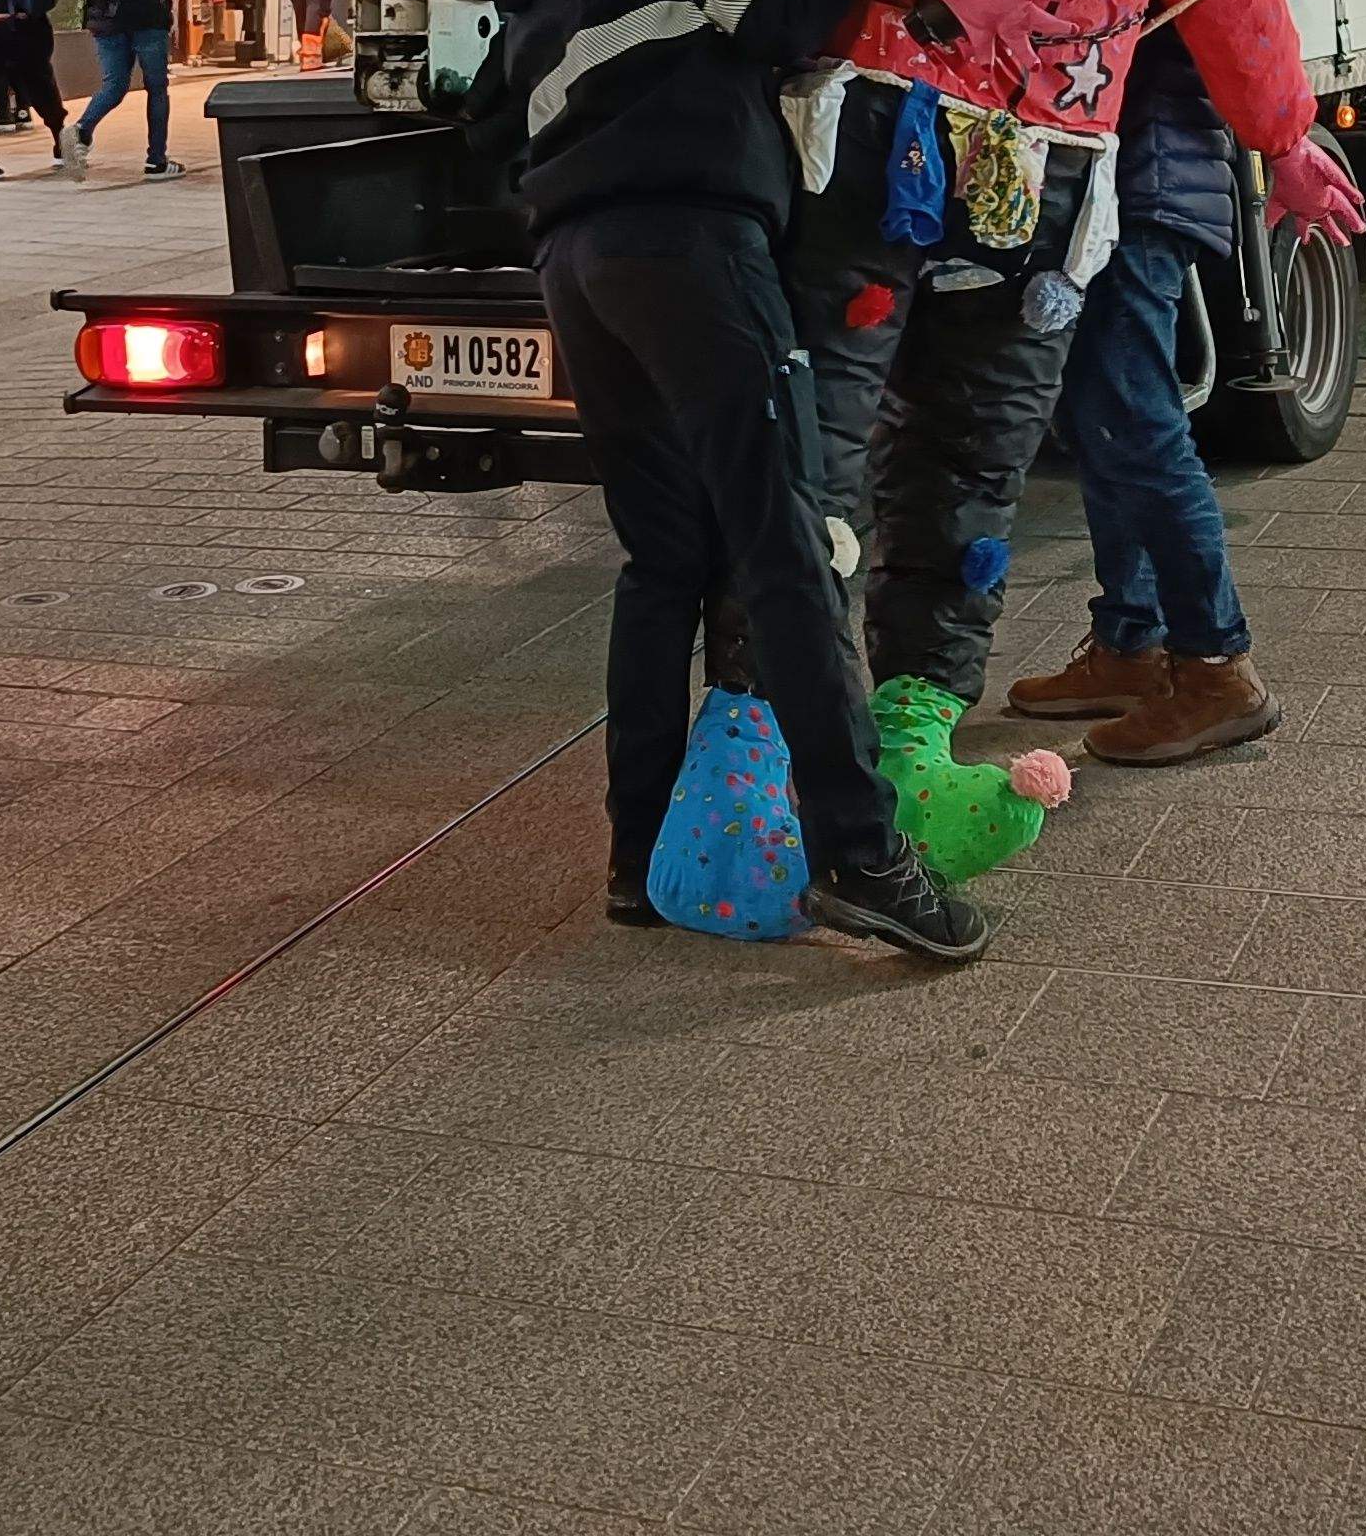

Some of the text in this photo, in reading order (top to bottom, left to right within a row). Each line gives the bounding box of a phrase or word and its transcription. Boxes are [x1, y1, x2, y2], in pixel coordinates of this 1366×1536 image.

[444, 335, 541, 378] M 0582
[405, 375, 434, 388] AND
[443, 378, 539, 391] PRINCIPAT D'ANDORRA
